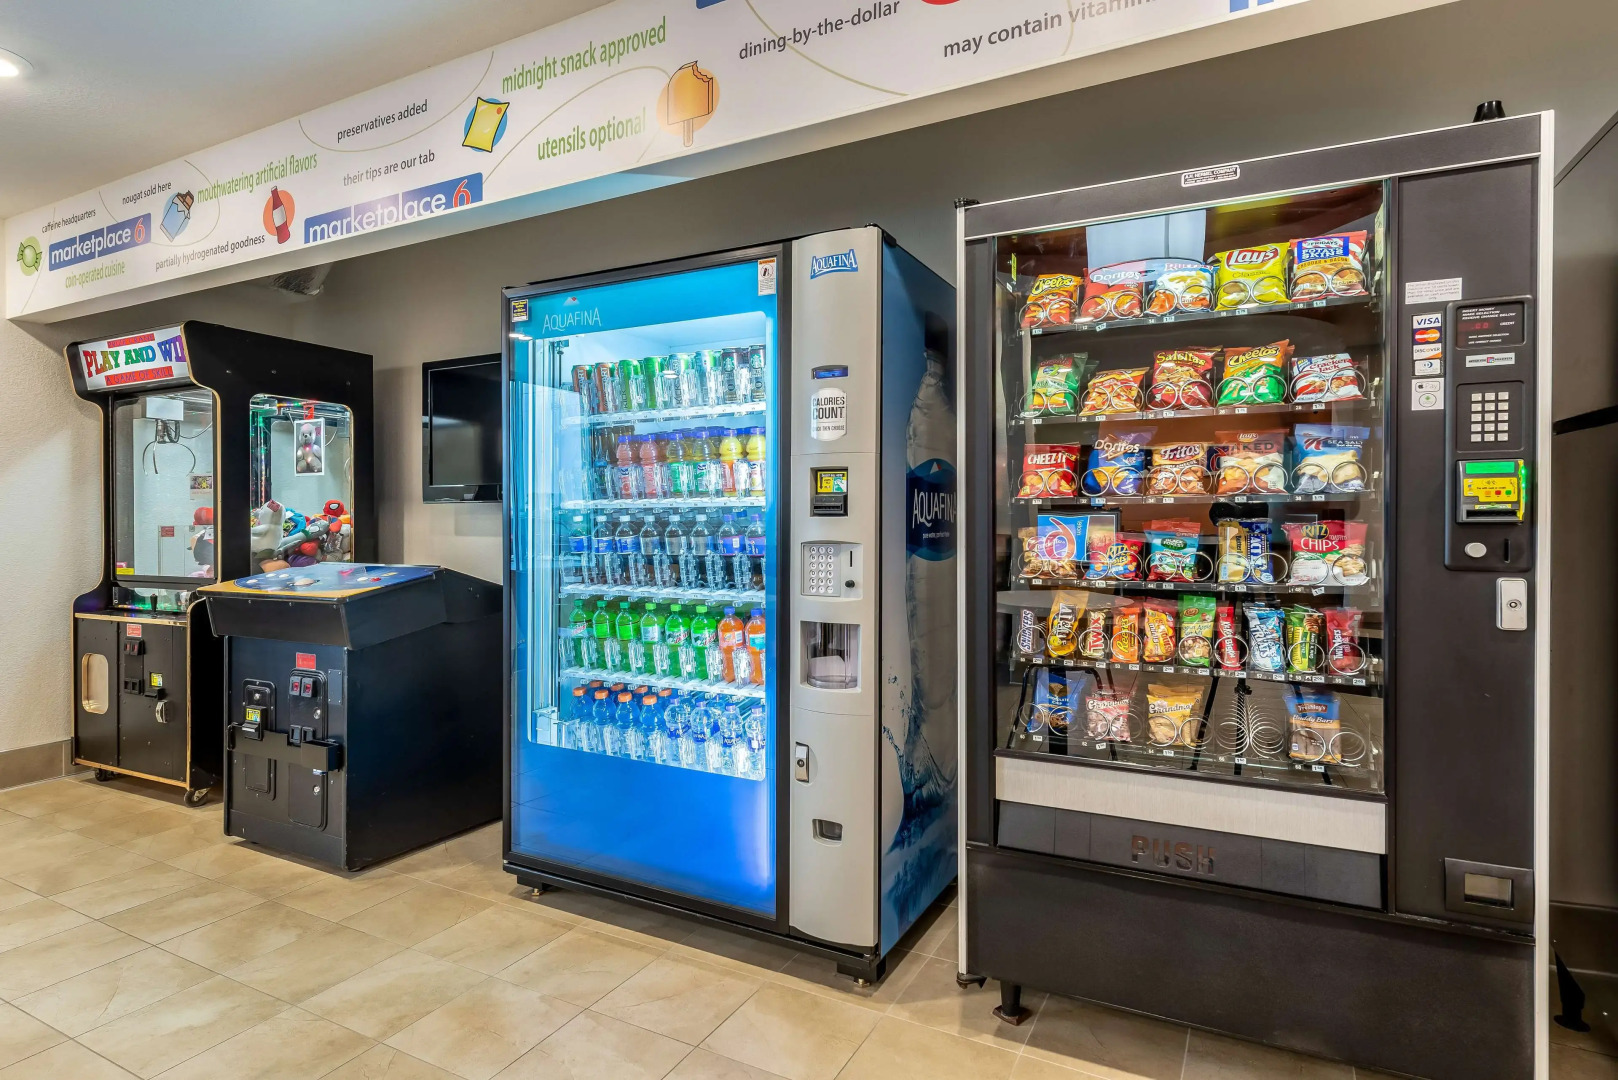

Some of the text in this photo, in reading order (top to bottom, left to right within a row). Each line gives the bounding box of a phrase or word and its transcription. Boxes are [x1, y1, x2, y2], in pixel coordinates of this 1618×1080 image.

[739, 1, 900, 60] dining-by-the-dollar
[943, 33, 983, 58] may
[987, 12, 1063, 45] contain
[502, 16, 667, 95] midnight snack approved
[337, 99, 429, 143] preservatives added
[537, 107, 647, 161] utensils optional
[197, 153, 318, 204] mouthwatering artificial flavors
[343, 150, 436, 187] their tips are our tab
[122, 182, 172, 206] nougat sold here
[41, 208, 96, 234] caffeine headquarters
[309, 180, 472, 243] marketplace 6
[51, 217, 146, 264] marketplace 6
[155, 234, 266, 272] partially hydrogenated goodness
[65, 259, 125, 289] coin-operated cuisine
[811, 250, 858, 277] AQUAFINA
[1092, 269, 1142, 284] Doritos
[1032, 277, 1073, 295] Cheetos
[542, 307, 602, 334] AQUAFINA
[1416, 317, 1440, 325] VISA
[83, 350, 120, 378] PLAY
[124, 345, 156, 366] AND
[1229, 346, 1280, 367] Cheetos
[1310, 358, 1352, 369] Cracker
[1319, 364, 1340, 373] Jack
[113, 372, 137, 385] GAME
[138, 371, 150, 381] OF
[151, 366, 174, 379] SKILL
[813, 396, 845, 407] CALORIES
[813, 406, 845, 420] COUNT
[1094, 439, 1140, 454] Doritos
[1161, 445, 1200, 460] Fritos
[1302, 524, 1328, 537] RITZ
[1300, 538, 1340, 551] CHIPS
[1021, 609, 1034, 652] SNICKERS
[1088, 616, 1104, 655] TWIX
[1316, 716, 1334, 724] Bars
[1131, 835, 1217, 876] PUSH
